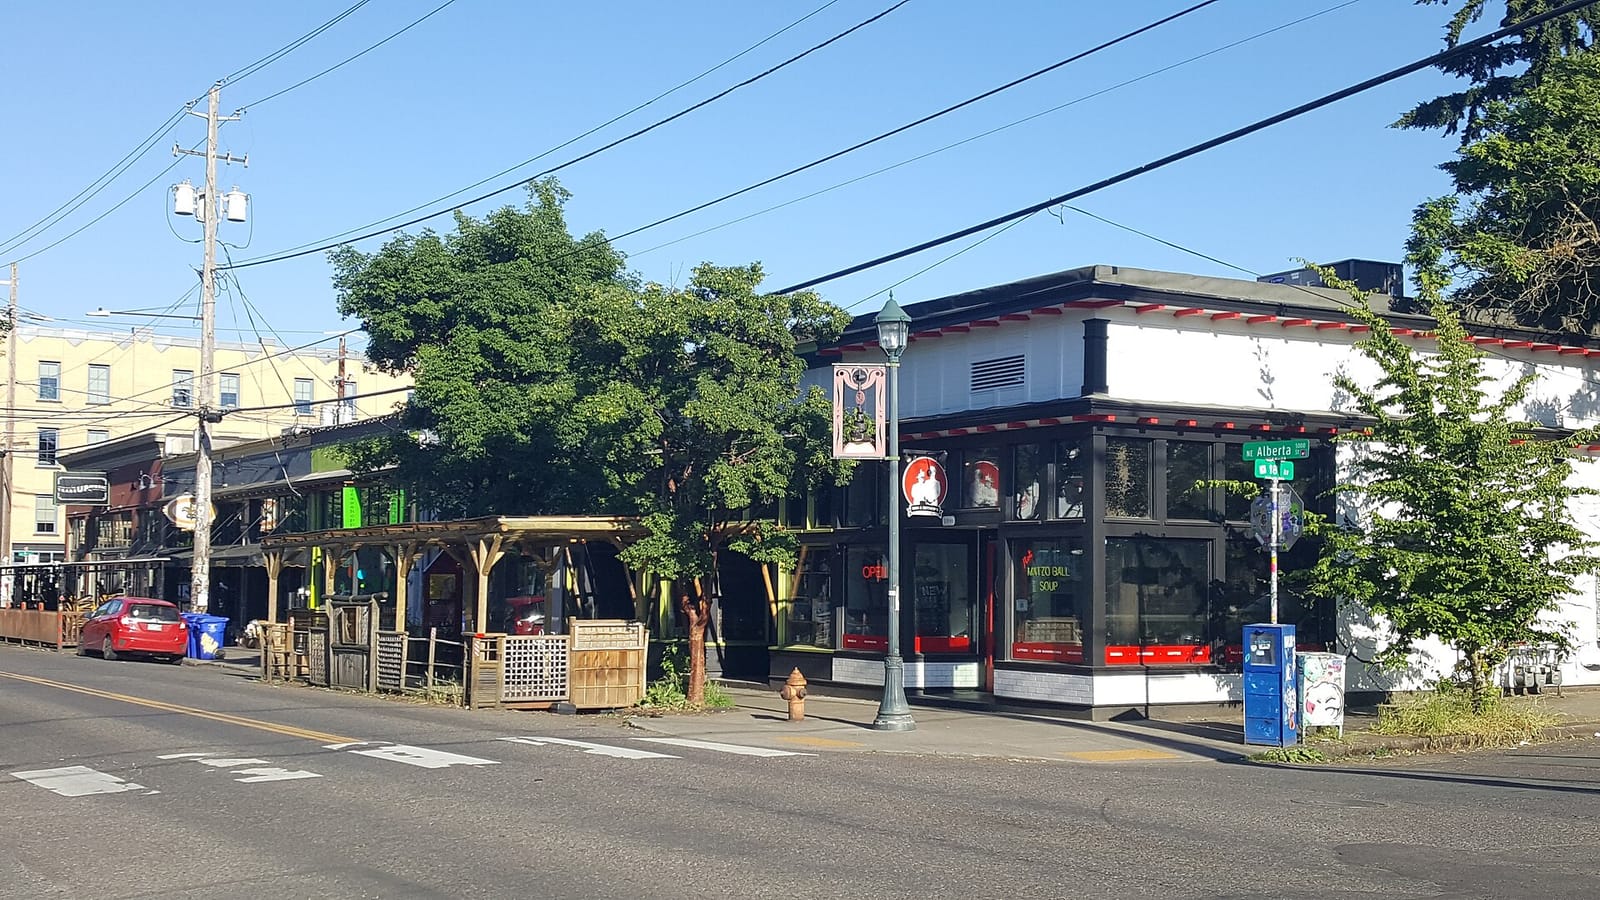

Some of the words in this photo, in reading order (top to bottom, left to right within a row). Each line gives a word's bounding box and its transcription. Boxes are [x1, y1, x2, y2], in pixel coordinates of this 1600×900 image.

[1246, 449, 1253, 457] NE
[1256, 445, 1292, 457] Alberta
[1027, 566, 1051, 577] MATZO
[1051, 566, 1070, 577] BALL
[1039, 581, 1059, 591] SOUP
